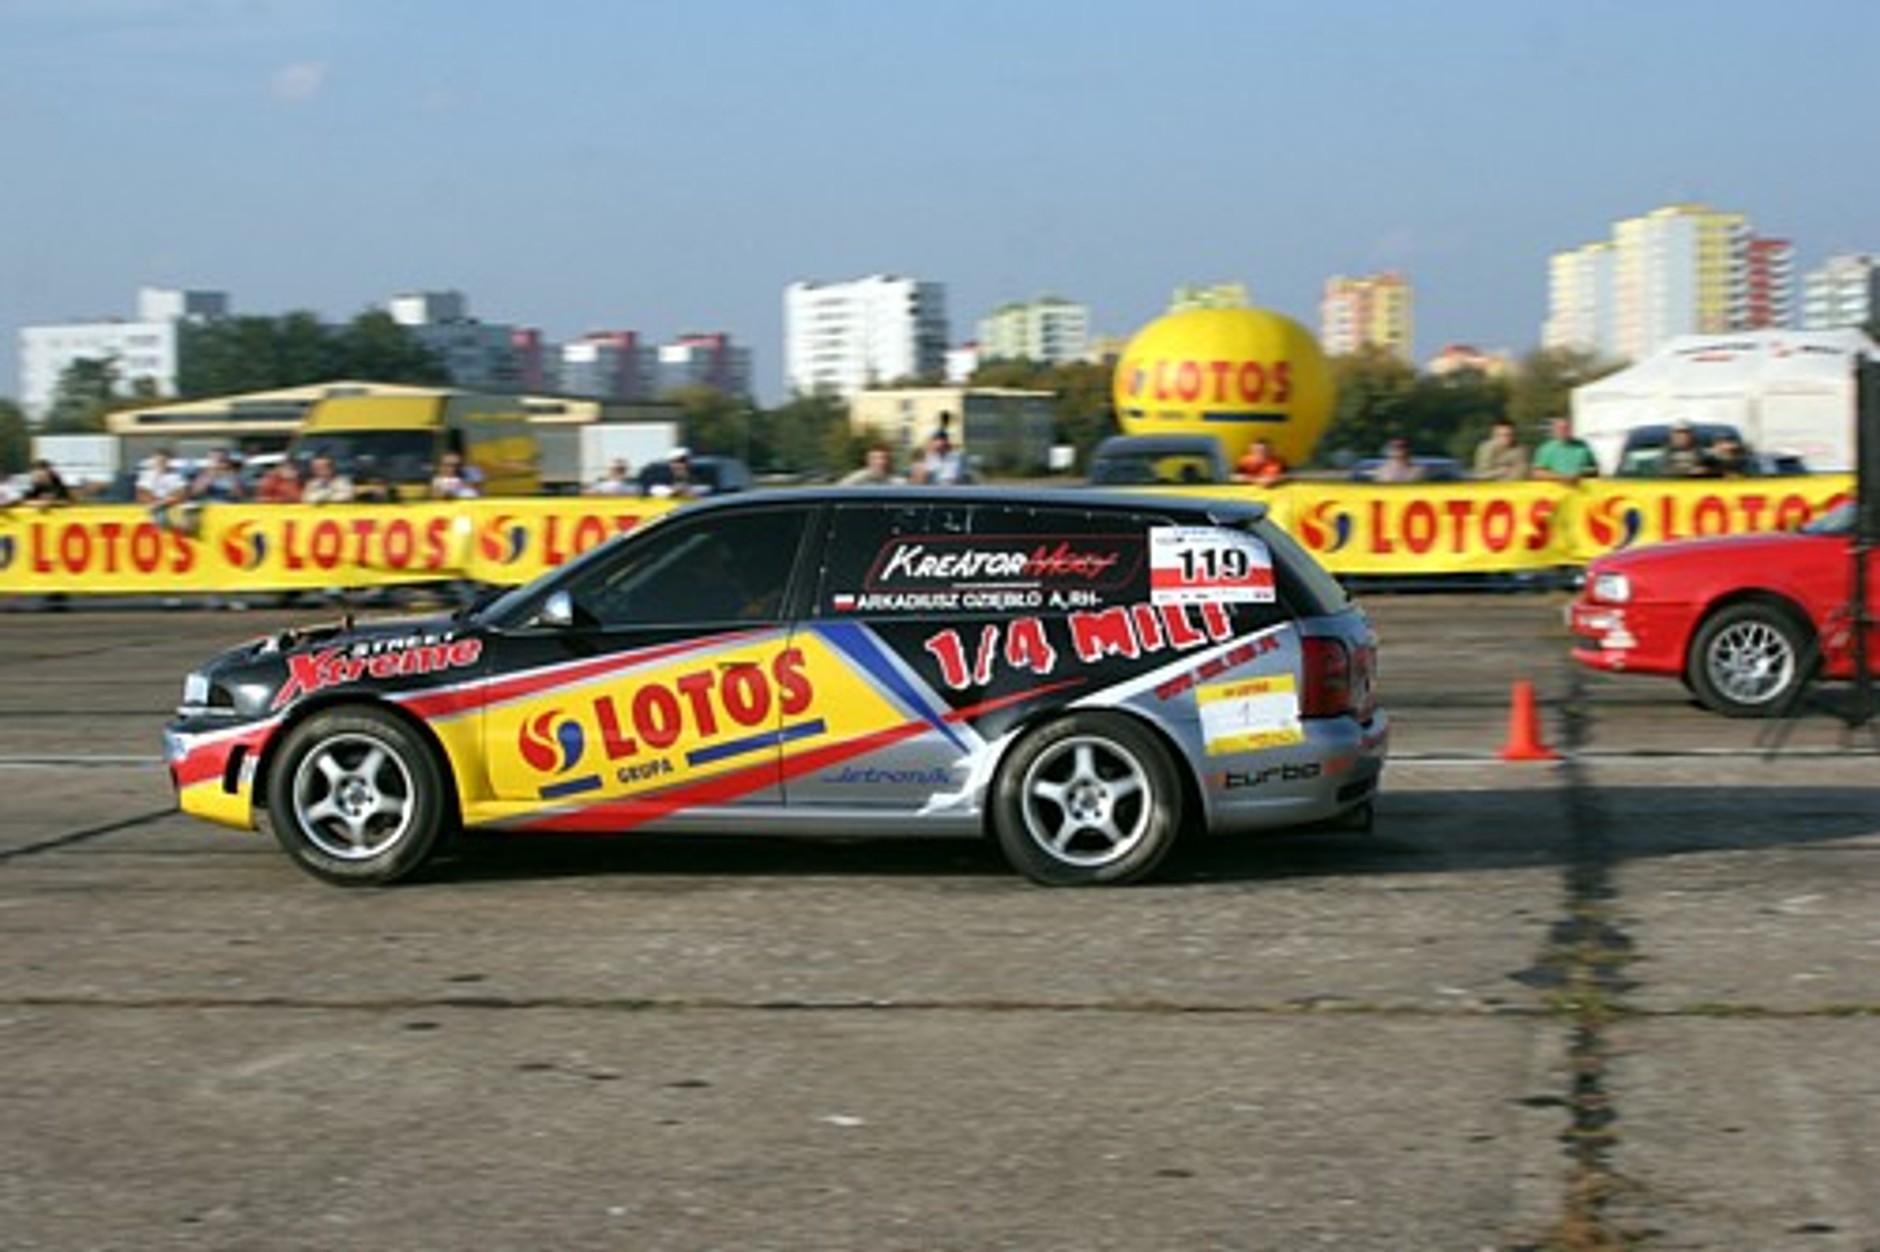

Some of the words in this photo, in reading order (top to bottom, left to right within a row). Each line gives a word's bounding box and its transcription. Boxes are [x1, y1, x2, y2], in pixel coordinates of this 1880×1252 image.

[1155, 360, 1290, 403] LOTOS
[29, 521, 197, 575] LOTOS
[283, 518, 450, 570] LOTOS
[1370, 498, 1556, 554] LOTOS
[1177, 548, 1248, 581] 119
[270, 637, 483, 711] Xtreme
[924, 615, 1055, 689] 1/4
[594, 647, 813, 762] LOTOS
[617, 759, 674, 784] GRUPA
[1226, 762, 1321, 789] turbo
